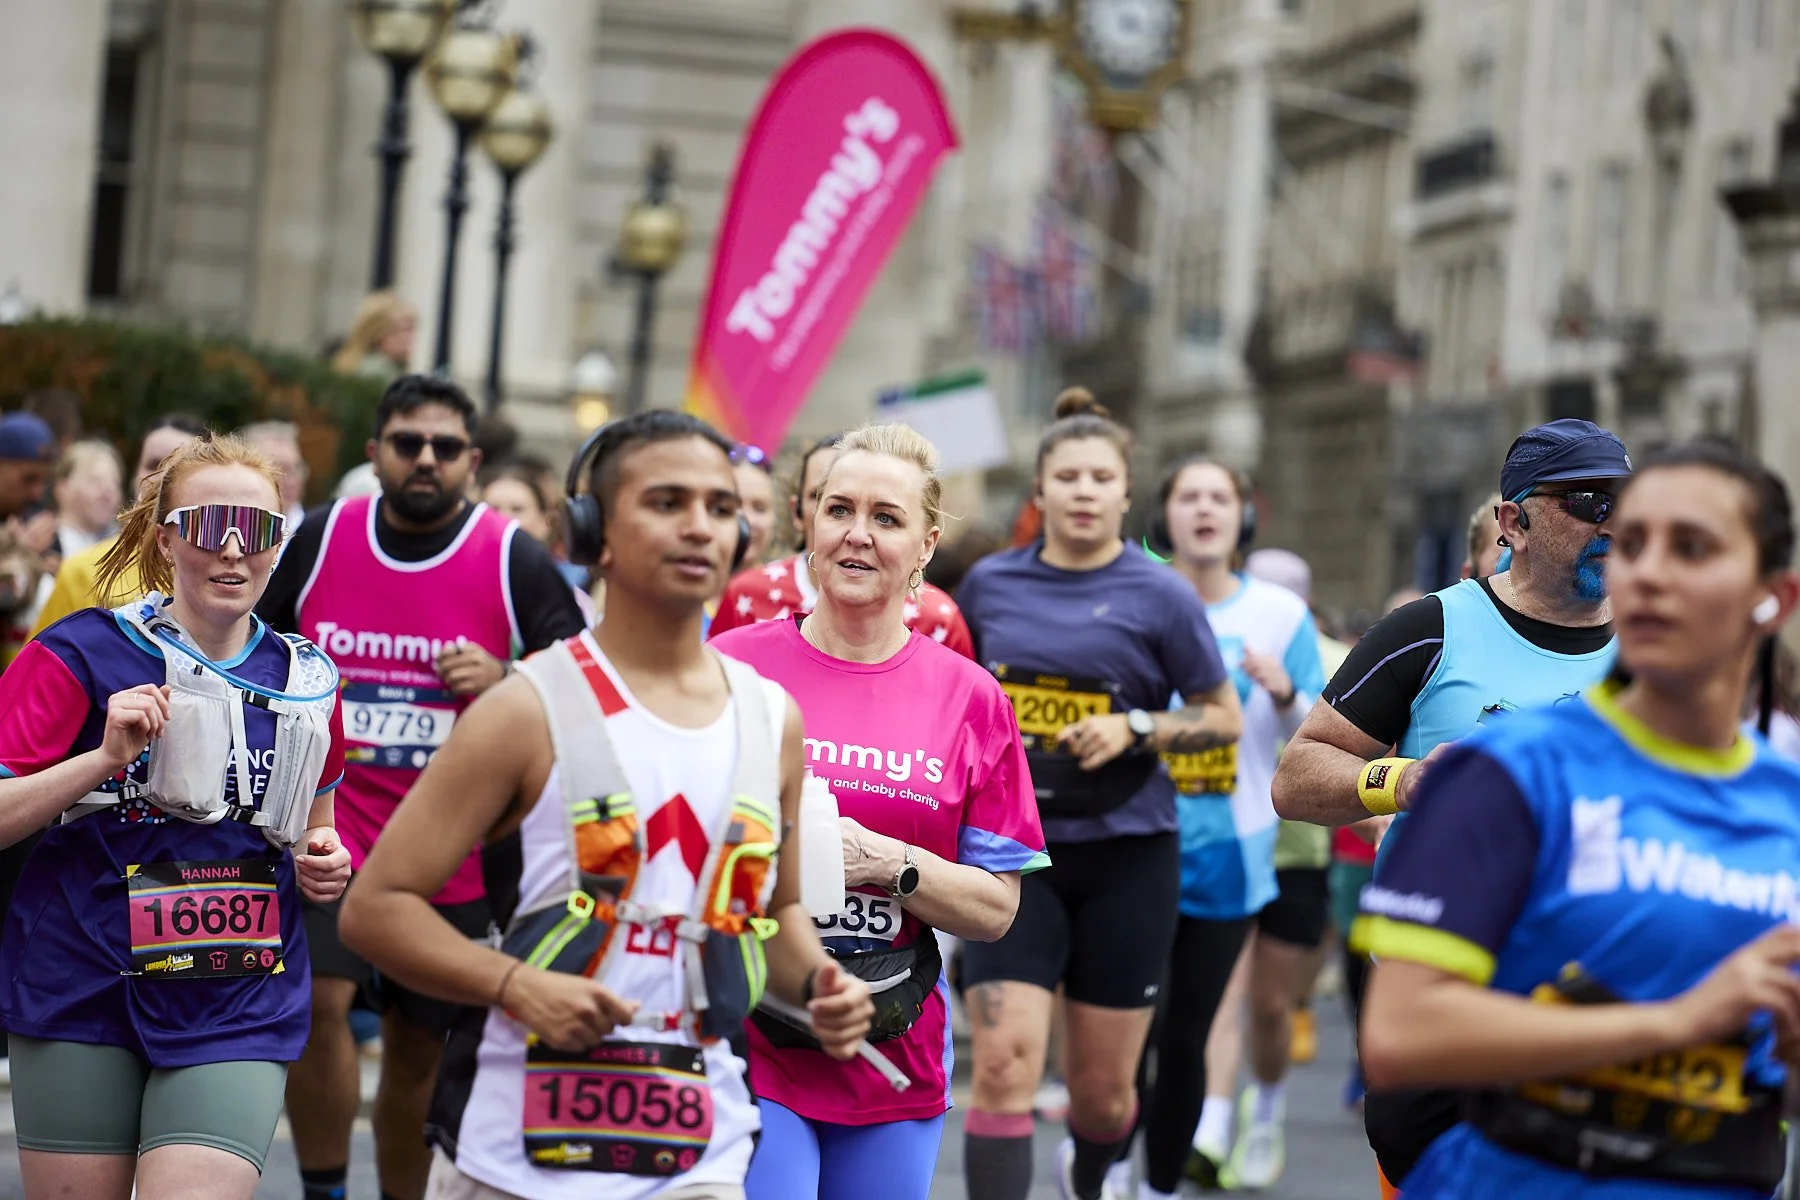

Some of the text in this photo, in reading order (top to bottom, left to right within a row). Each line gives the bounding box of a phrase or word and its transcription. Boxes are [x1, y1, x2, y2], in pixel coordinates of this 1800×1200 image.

[726, 97, 900, 342] Tommy's
[353, 708, 435, 739] 9779
[227, 748, 276, 771] ANC
[801, 737, 945, 784] mmy's
[833, 778, 859, 790] and
[862, 781, 896, 798] baby
[899, 788, 939, 811] charity
[181, 866, 241, 880] HANNAH
[144, 894, 271, 937] 16687
[539, 1076, 704, 1129] 15058
